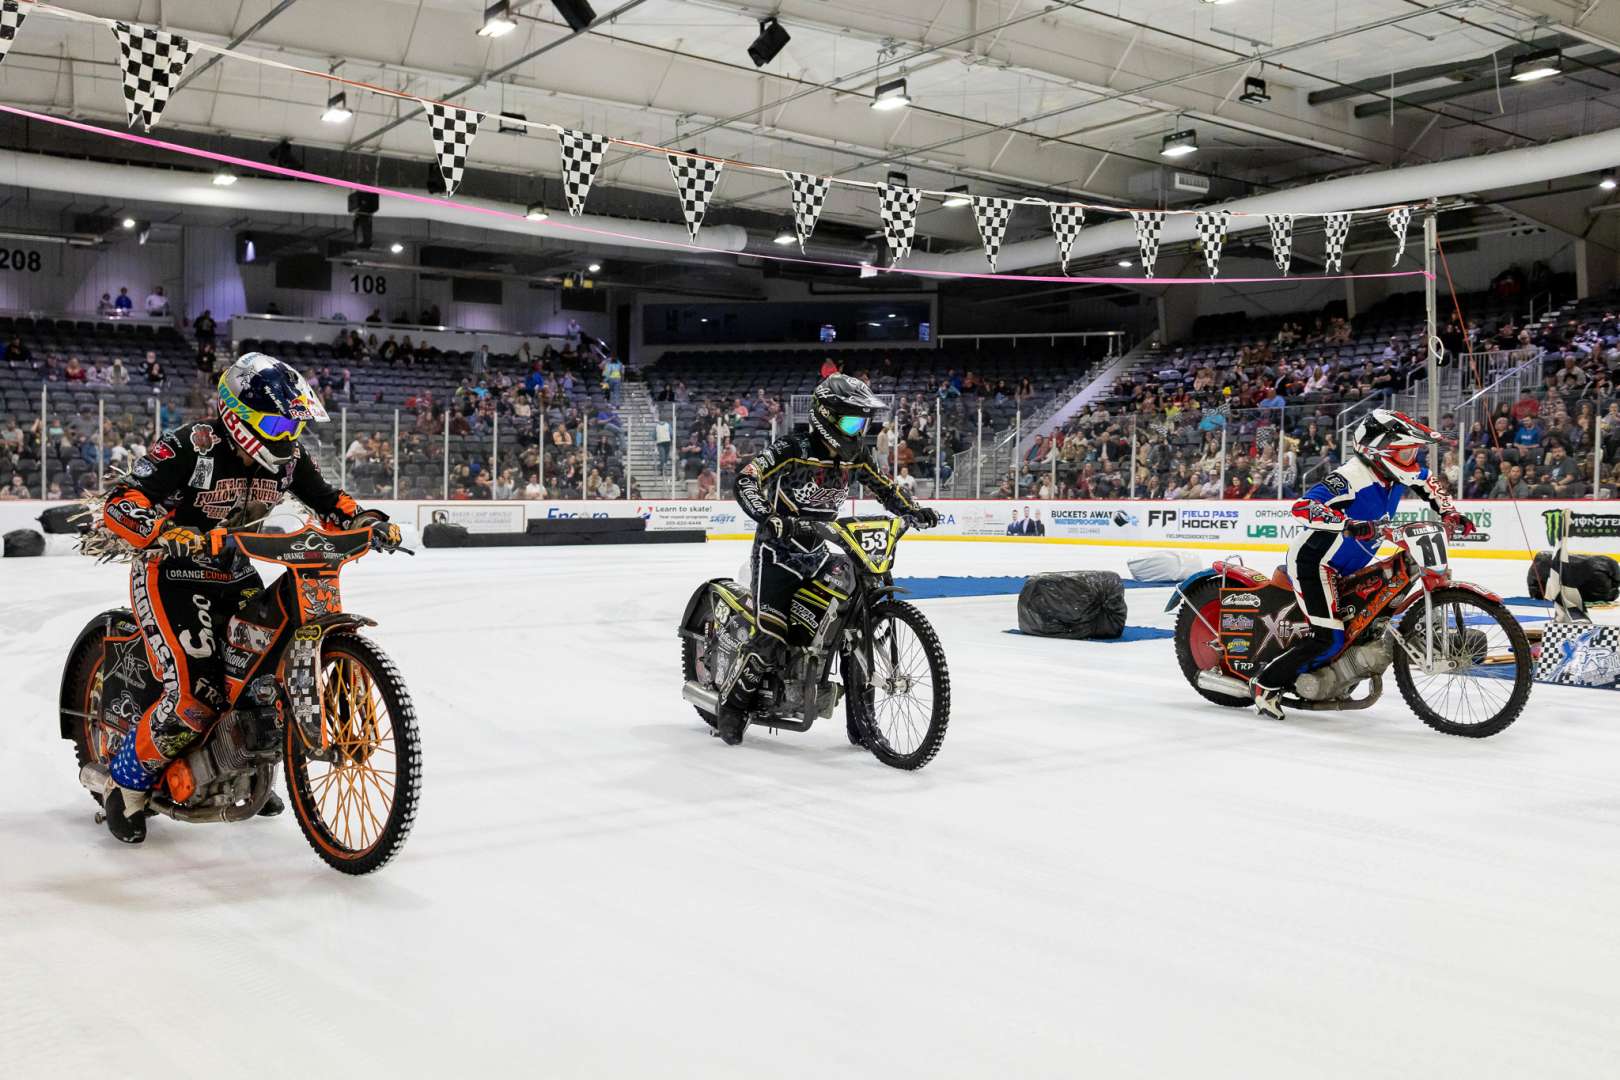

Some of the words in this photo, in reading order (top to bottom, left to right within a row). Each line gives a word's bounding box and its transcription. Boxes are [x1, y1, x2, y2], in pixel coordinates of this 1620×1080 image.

[0, 248, 41, 272] 208
[351, 275, 387, 295] 108
[223, 410, 263, 457] Bull
[195, 489, 236, 506] FOLLOW
[1051, 510, 1087, 519] BUCKETS
[1090, 510, 1113, 519] AWAY
[1148, 510, 1177, 527] FP
[1569, 516, 1620, 527] MONSTE
[1182, 520, 1238, 528] HOCKEY
[1247, 525, 1278, 538] UAB
[861, 531, 887, 551] 53
[1416, 533, 1447, 567] 11
[170, 568, 205, 580] ORANGE
[714, 598, 731, 624] 53
